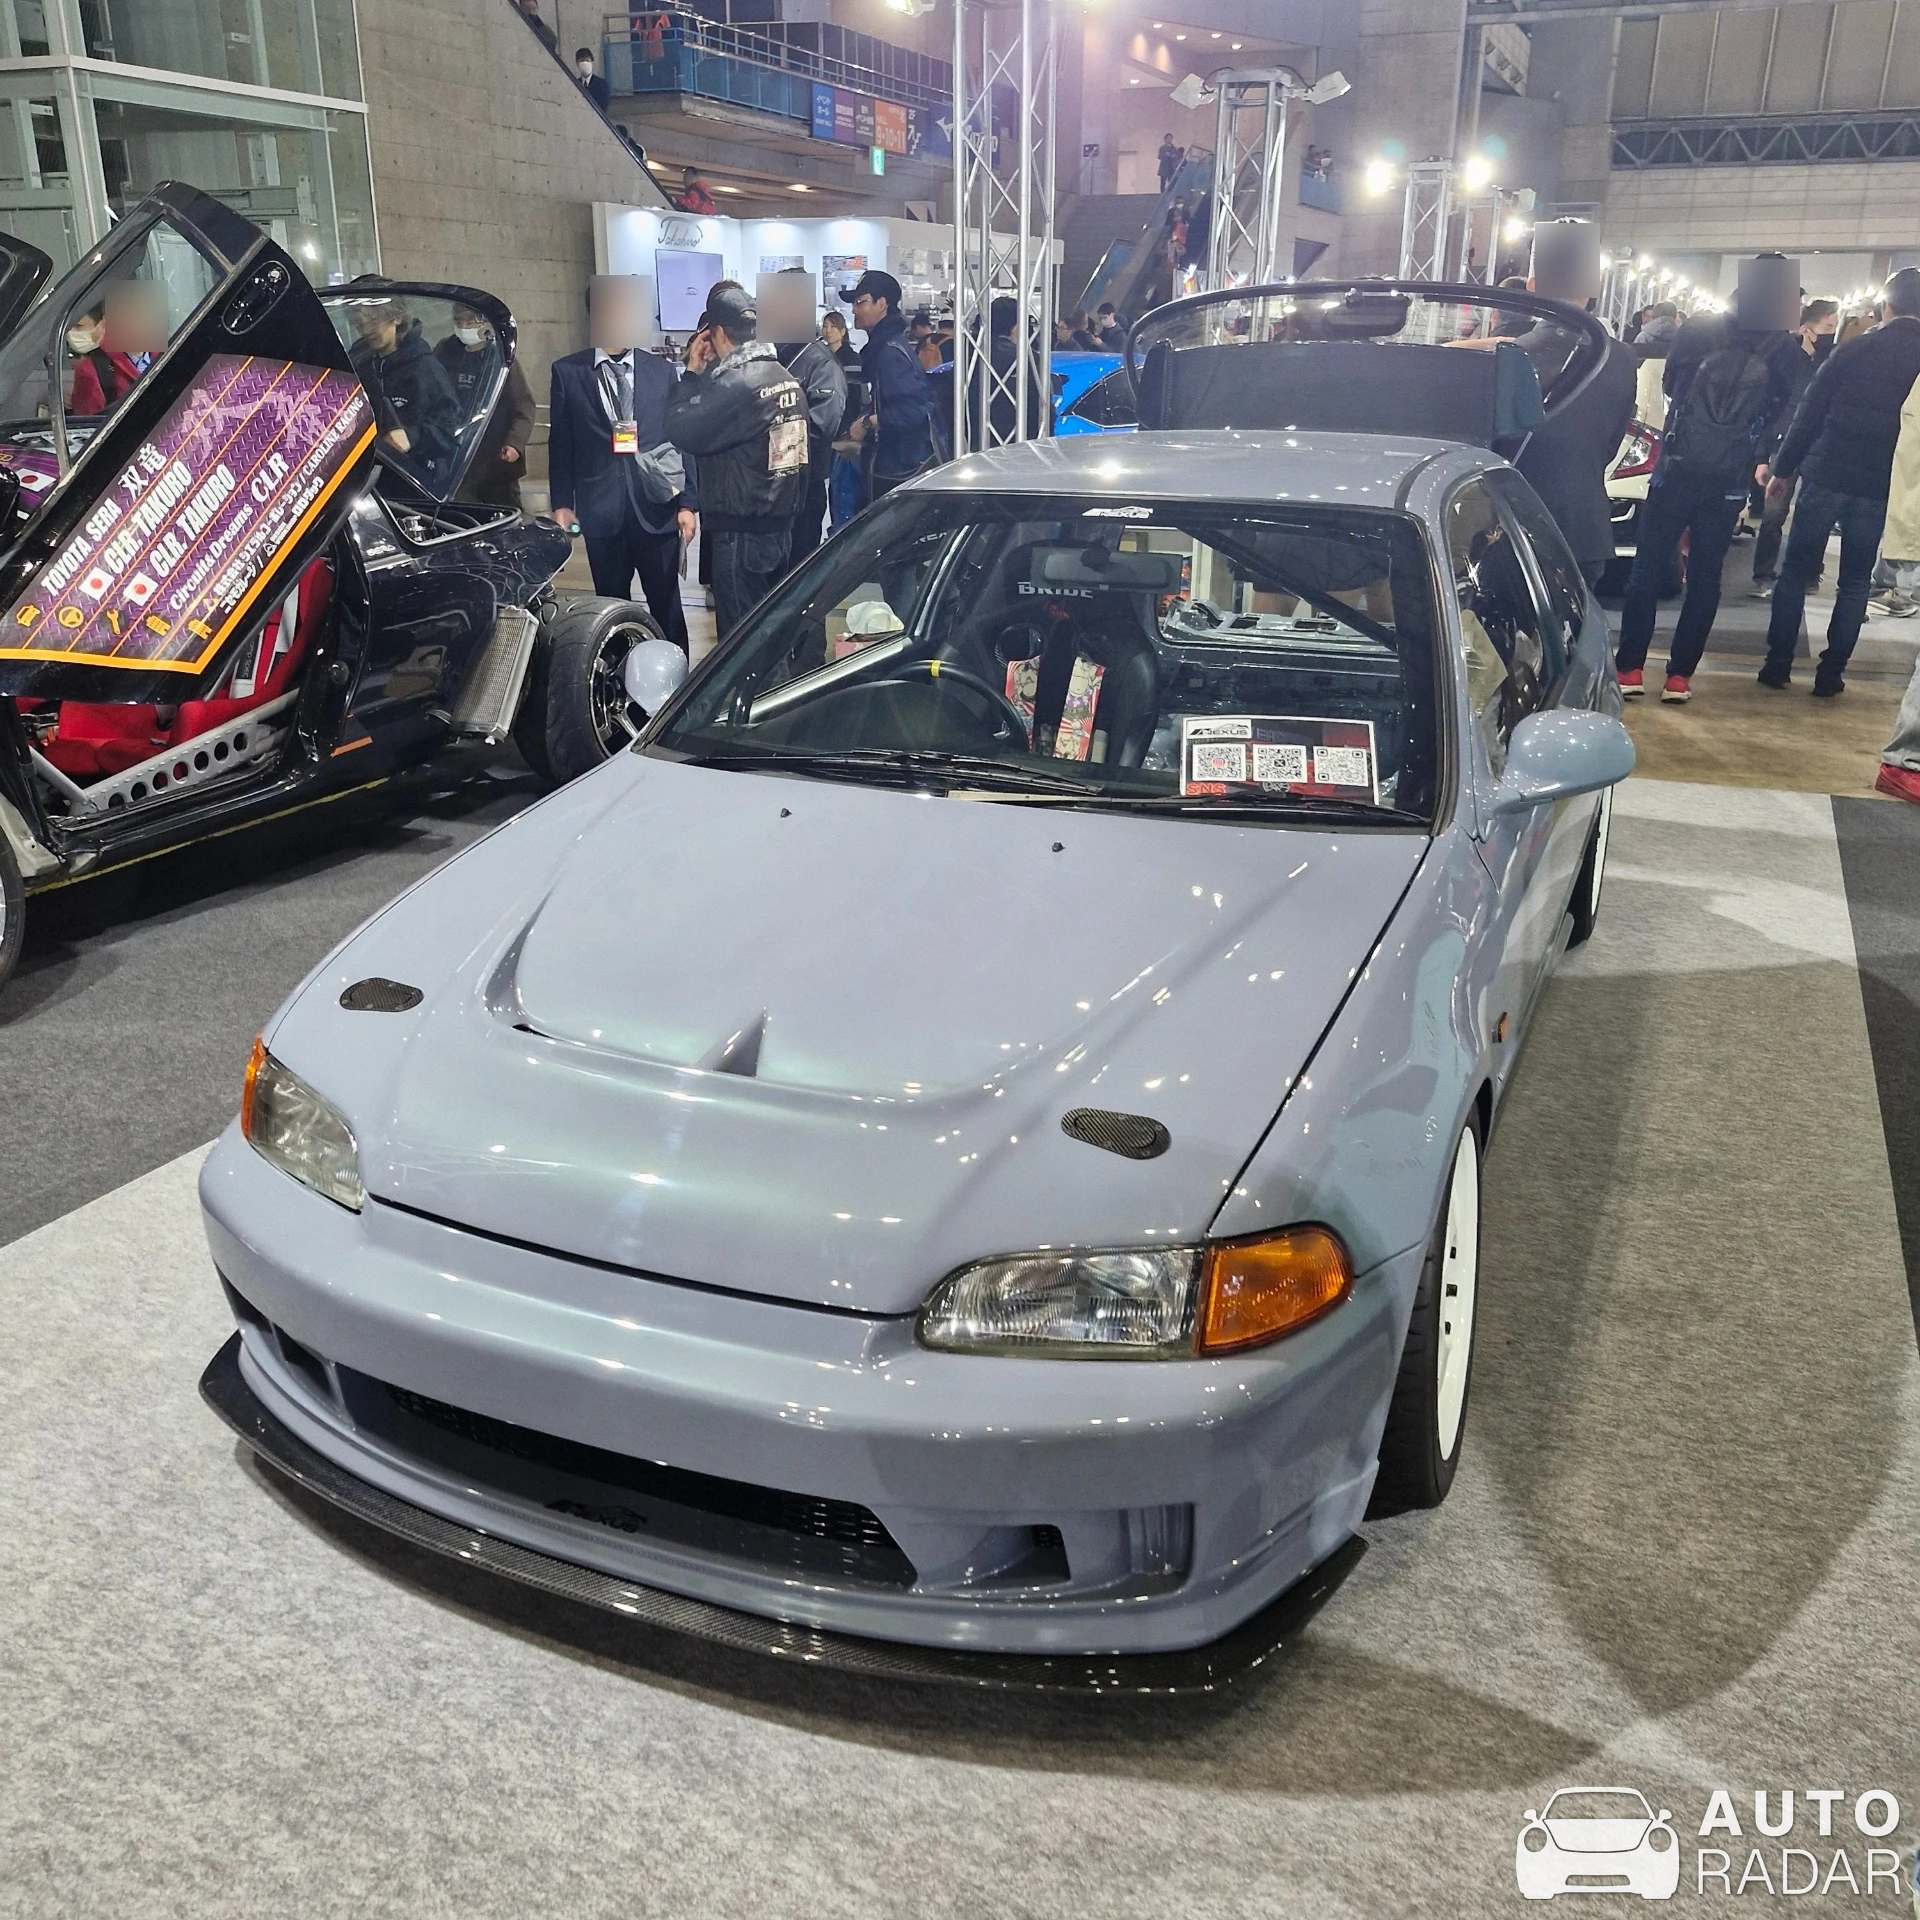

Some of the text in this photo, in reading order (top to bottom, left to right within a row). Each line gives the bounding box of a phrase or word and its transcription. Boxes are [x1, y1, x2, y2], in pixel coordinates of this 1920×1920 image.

[251, 452, 290, 503] CLR
[302, 428, 340, 476] CAROLINE
[335, 396, 364, 434] RACING
[40, 443, 167, 597] TOYOTA SERA 双竜
[104, 460, 193, 574] CLR. TAKURO
[150, 463, 236, 578] CLR. TAKURO
[1186, 782, 1227, 796] SNS
